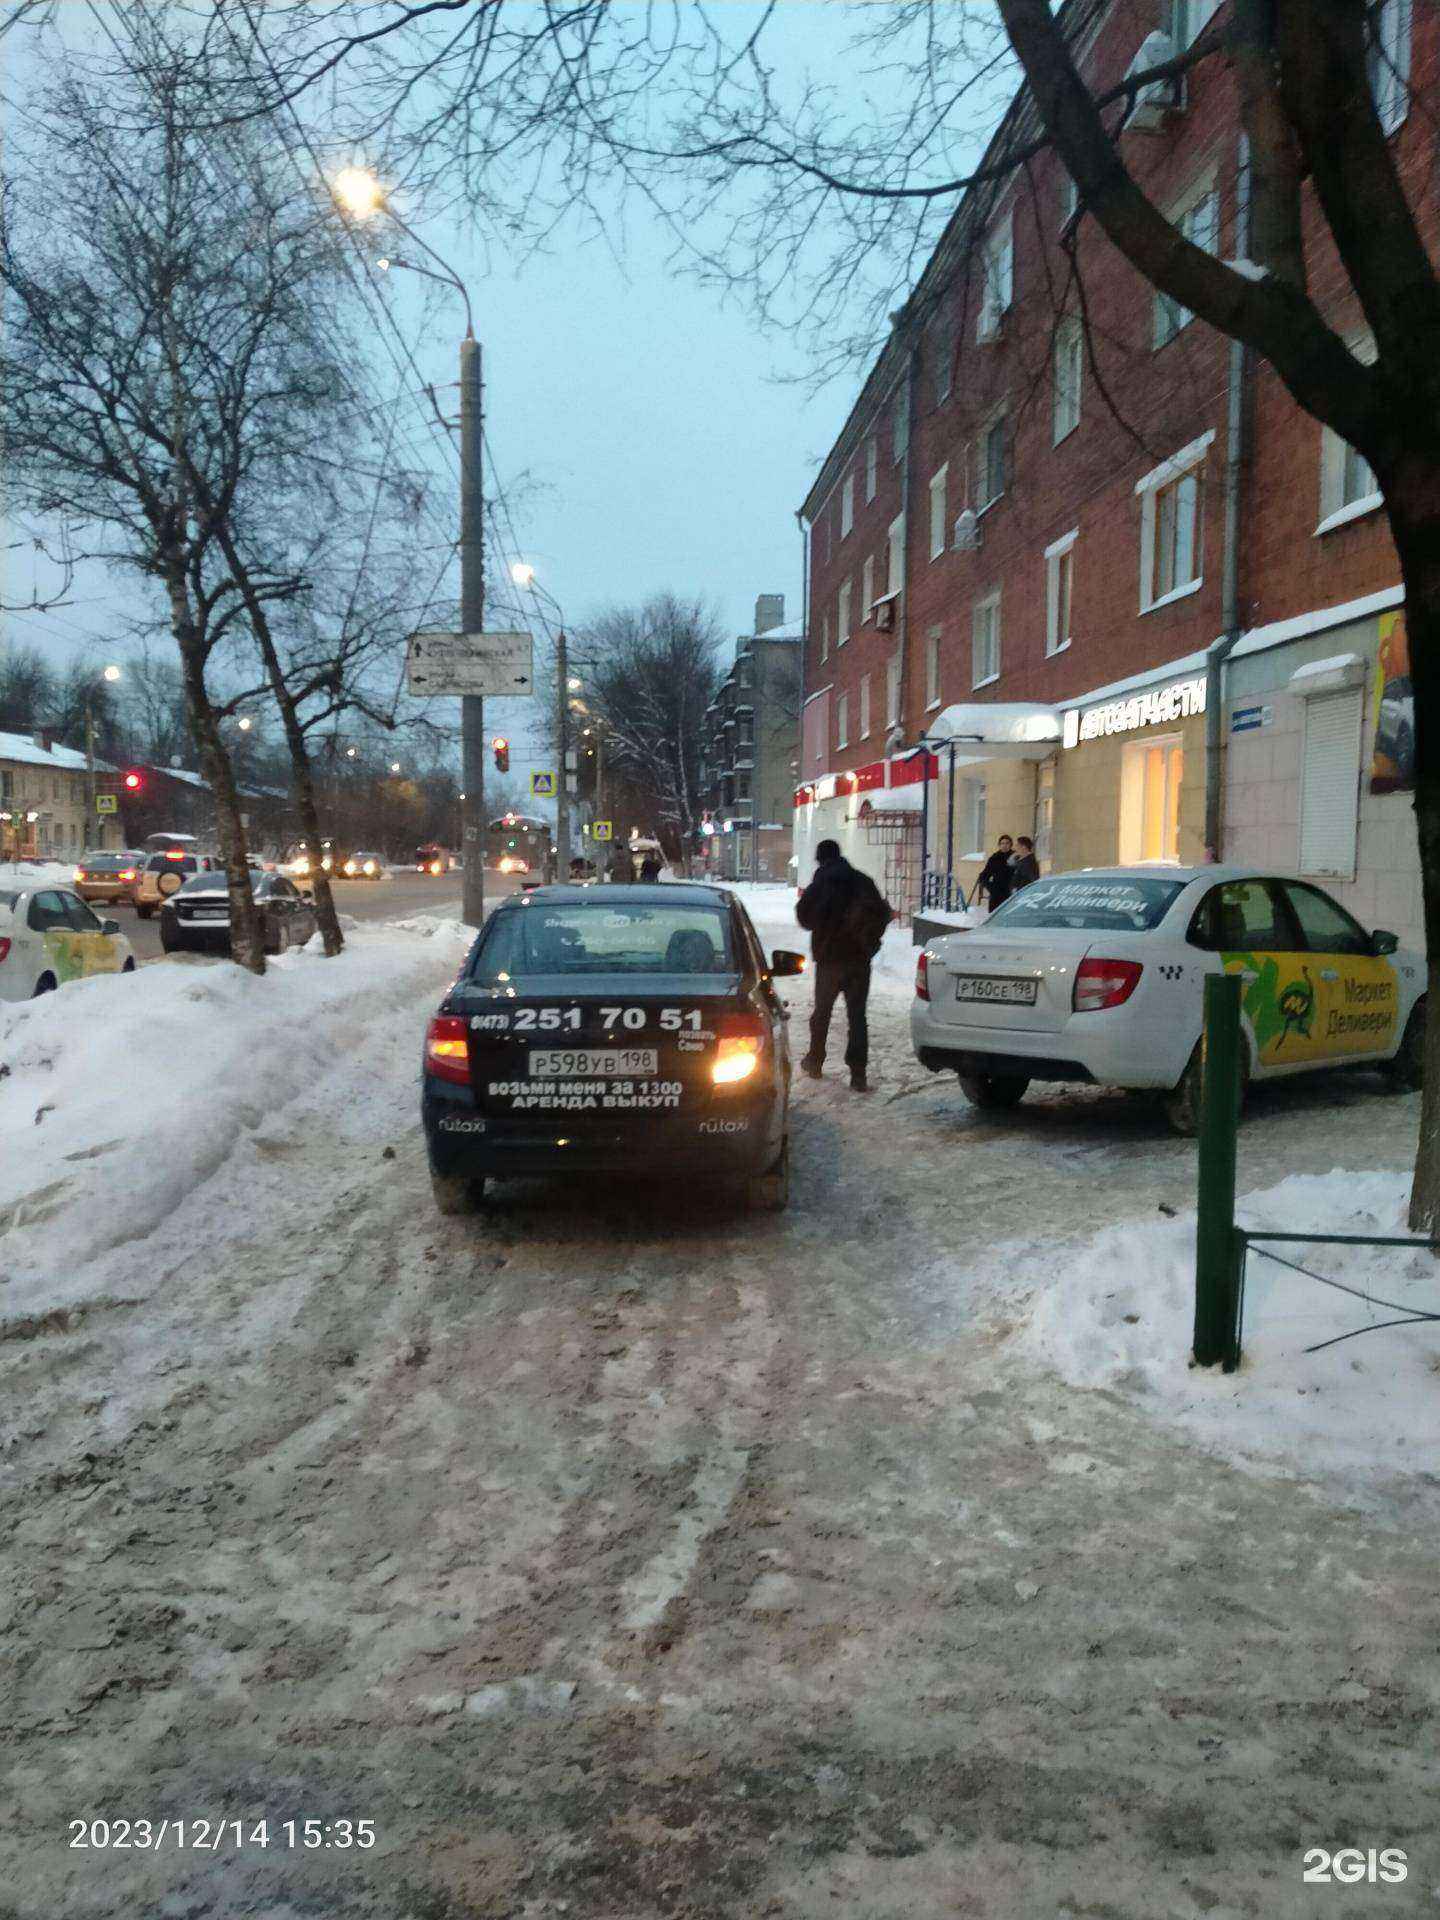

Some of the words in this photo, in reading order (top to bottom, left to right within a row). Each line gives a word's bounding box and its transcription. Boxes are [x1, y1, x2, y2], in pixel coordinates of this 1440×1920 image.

[1078, 676, 1208, 741] АВТОЗАПЧАСТИ
[1059, 884, 1131, 897] Маркет
[1044, 895, 1149, 912] Деливери
[1343, 977, 1393, 1006] Маркет
[514, 1008, 582, 1030] 251
[599, 1008, 647, 1029] 70
[659, 1009, 702, 1030] 51
[1325, 1008, 1393, 1040] Деливери
[536, 1053, 615, 1073] Р598УВ
[621, 1051, 652, 1067] 198
[639, 1082, 682, 1095] 1300
[512, 1097, 597, 1109] АРЕНДА
[603, 1096, 680, 1107] ВЫКУП
